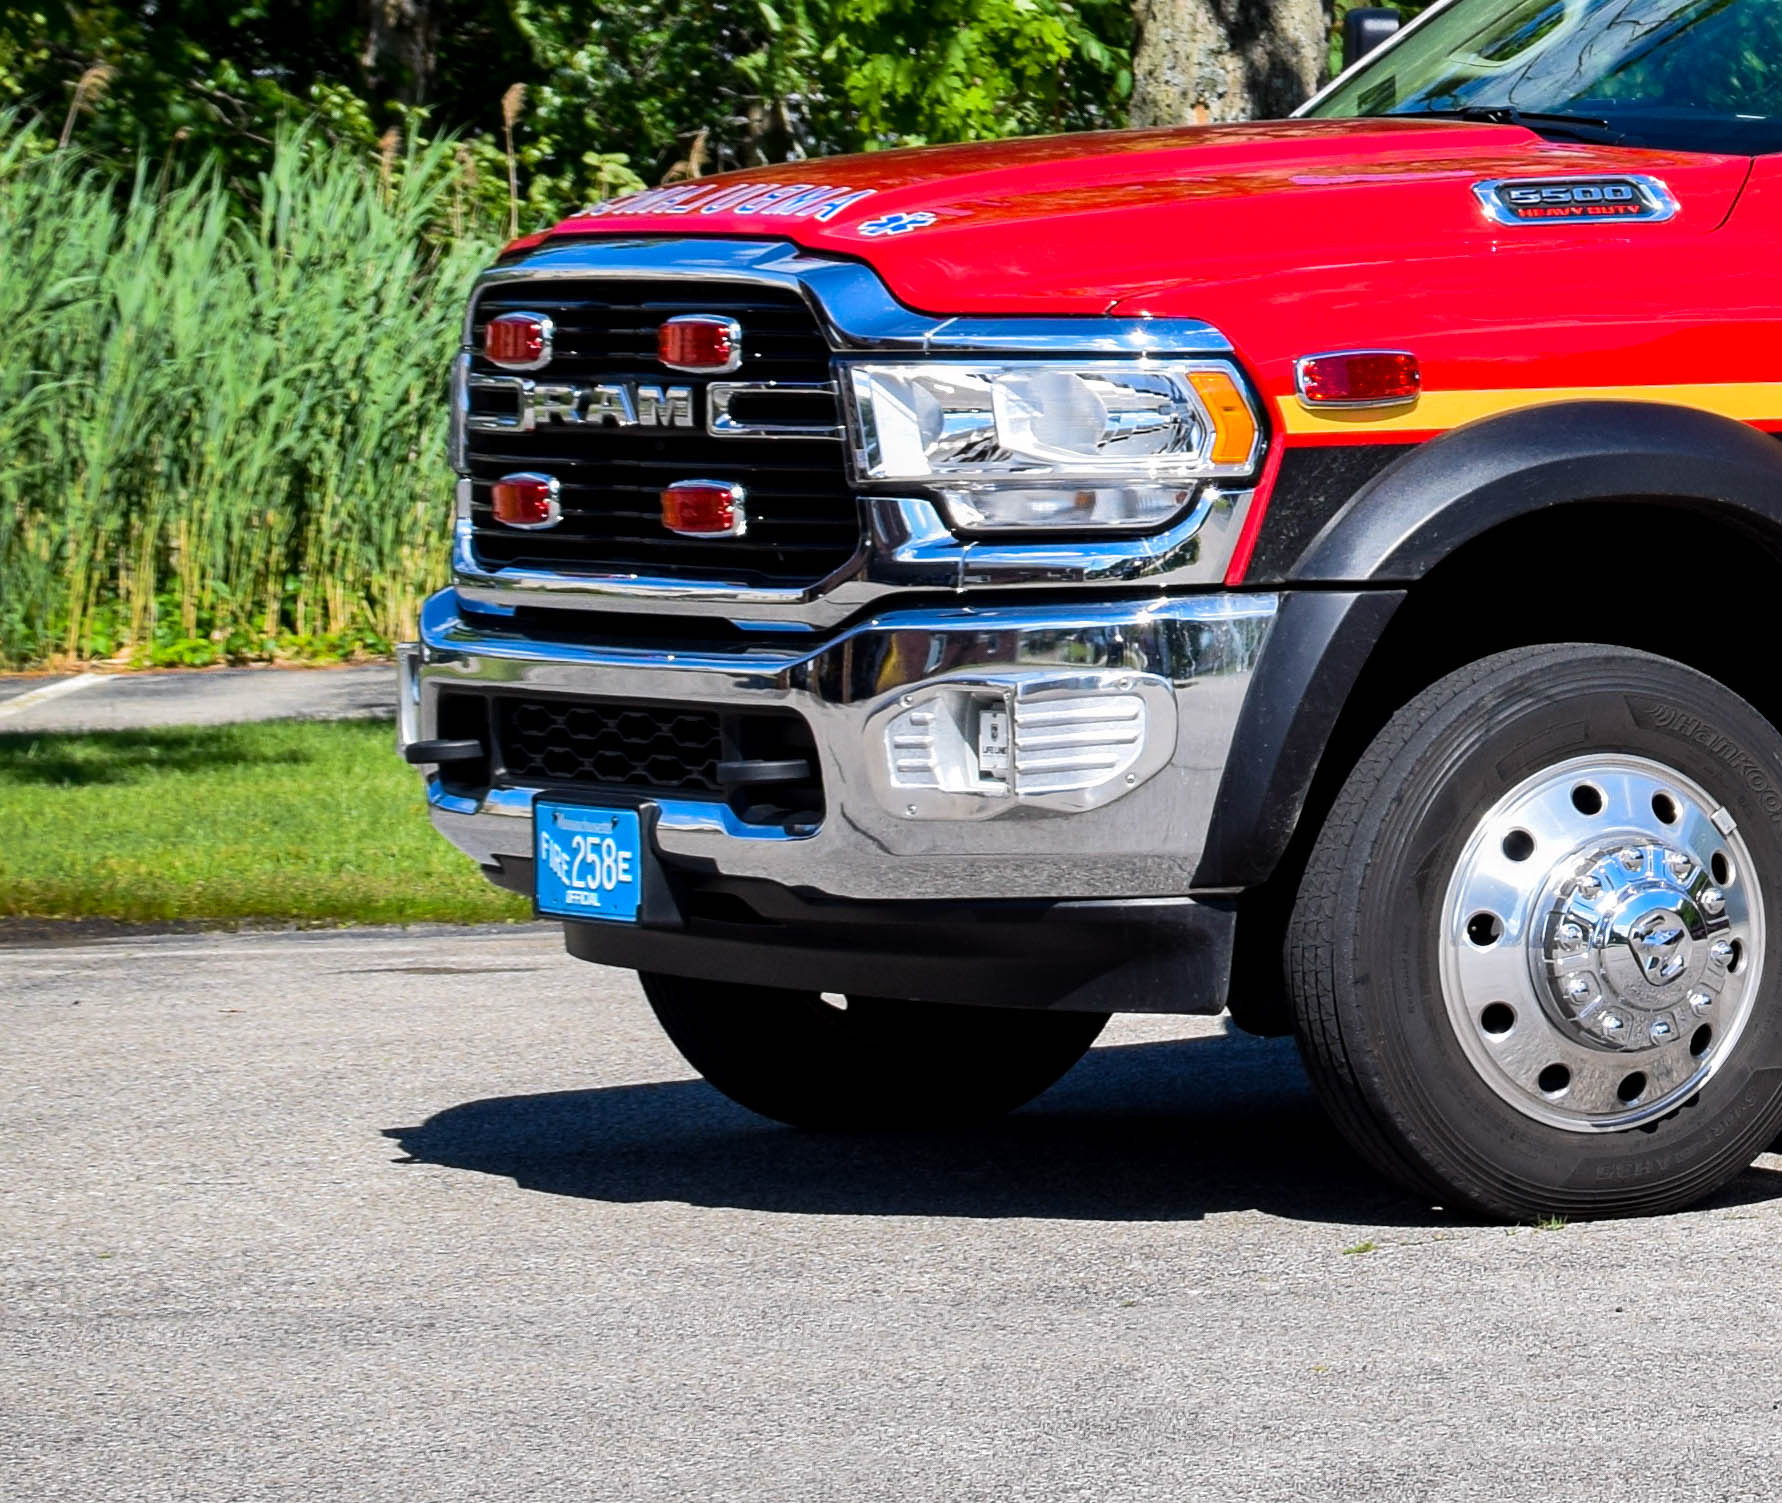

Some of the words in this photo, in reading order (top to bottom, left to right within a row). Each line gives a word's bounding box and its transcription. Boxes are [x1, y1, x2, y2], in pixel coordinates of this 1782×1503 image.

[1509, 186, 1633, 204] 5500
[1517, 206, 1586, 217] HEAVY
[1588, 205, 1641, 215] DUTY
[534, 383, 695, 427] RAM
[541, 831, 571, 887] FIRE
